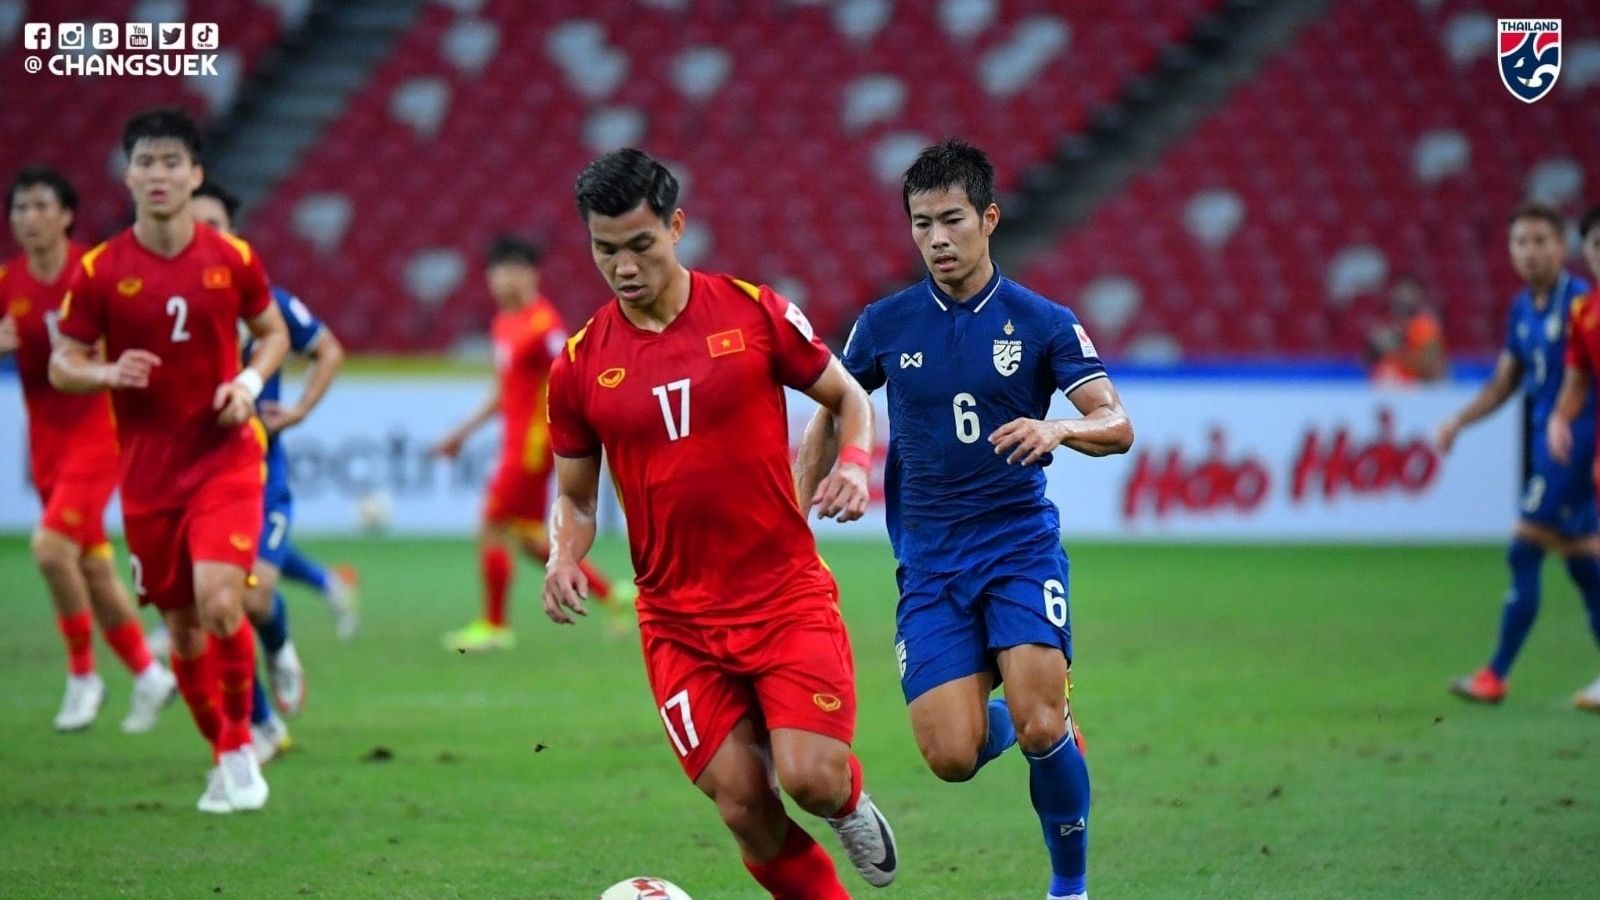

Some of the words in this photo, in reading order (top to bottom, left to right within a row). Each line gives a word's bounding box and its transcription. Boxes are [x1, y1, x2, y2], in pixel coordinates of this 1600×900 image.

[166, 296, 191, 342] 2
[652, 378, 691, 441] 17
[953, 392, 981, 444] 6
[267, 511, 288, 550] 7
[1042, 579, 1067, 628] 6
[661, 689, 700, 757] 17
